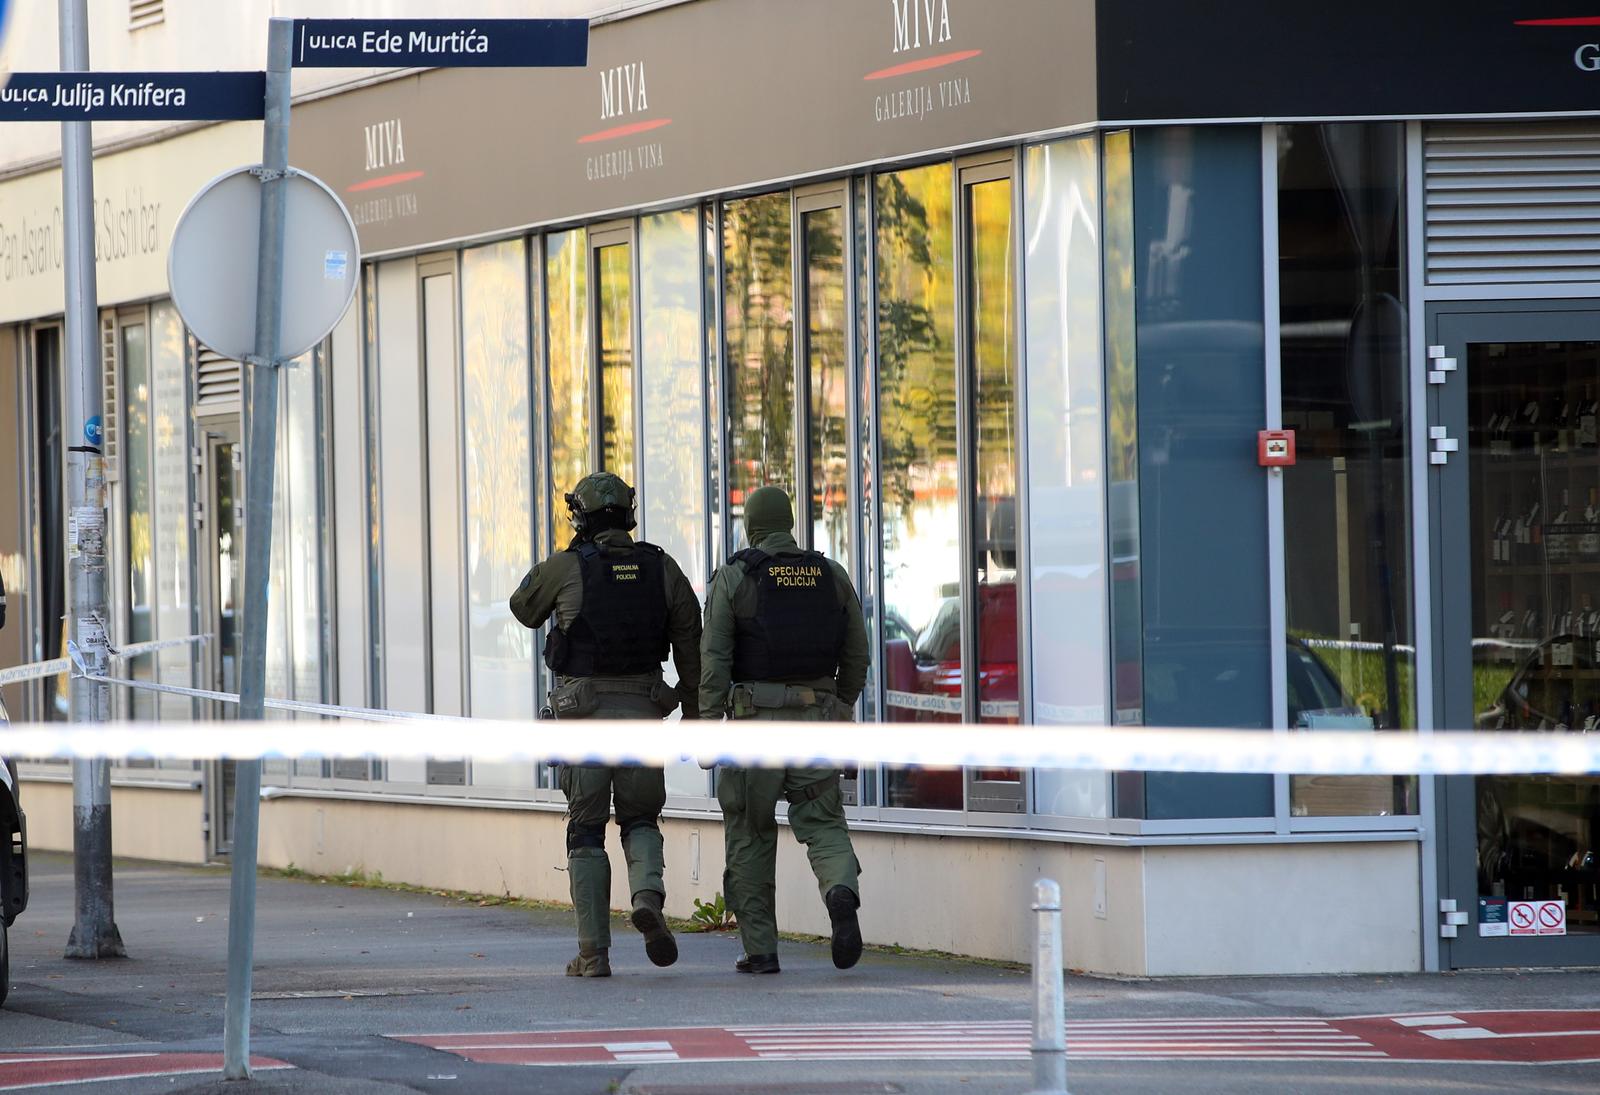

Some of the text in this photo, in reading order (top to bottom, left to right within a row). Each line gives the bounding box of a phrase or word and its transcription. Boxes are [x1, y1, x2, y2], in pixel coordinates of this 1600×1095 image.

[308, 28, 489, 53] ULICA Ede Murtića
[891, 0, 952, 53] MIVA
[1, 82, 186, 112] ULICA Julija Knifera
[600, 60, 648, 120] MIVA
[875, 77, 970, 121] GALERIJA VINA
[364, 118, 405, 170] MIVA
[586, 143, 663, 180] GALERIJA VINA
[21, 208, 51, 276] Asian
[103, 187, 138, 262] Sushi
[140, 184, 161, 254] bar
[768, 566, 823, 577] SPECIJALNA
[776, 576, 817, 587] POLICIJA
